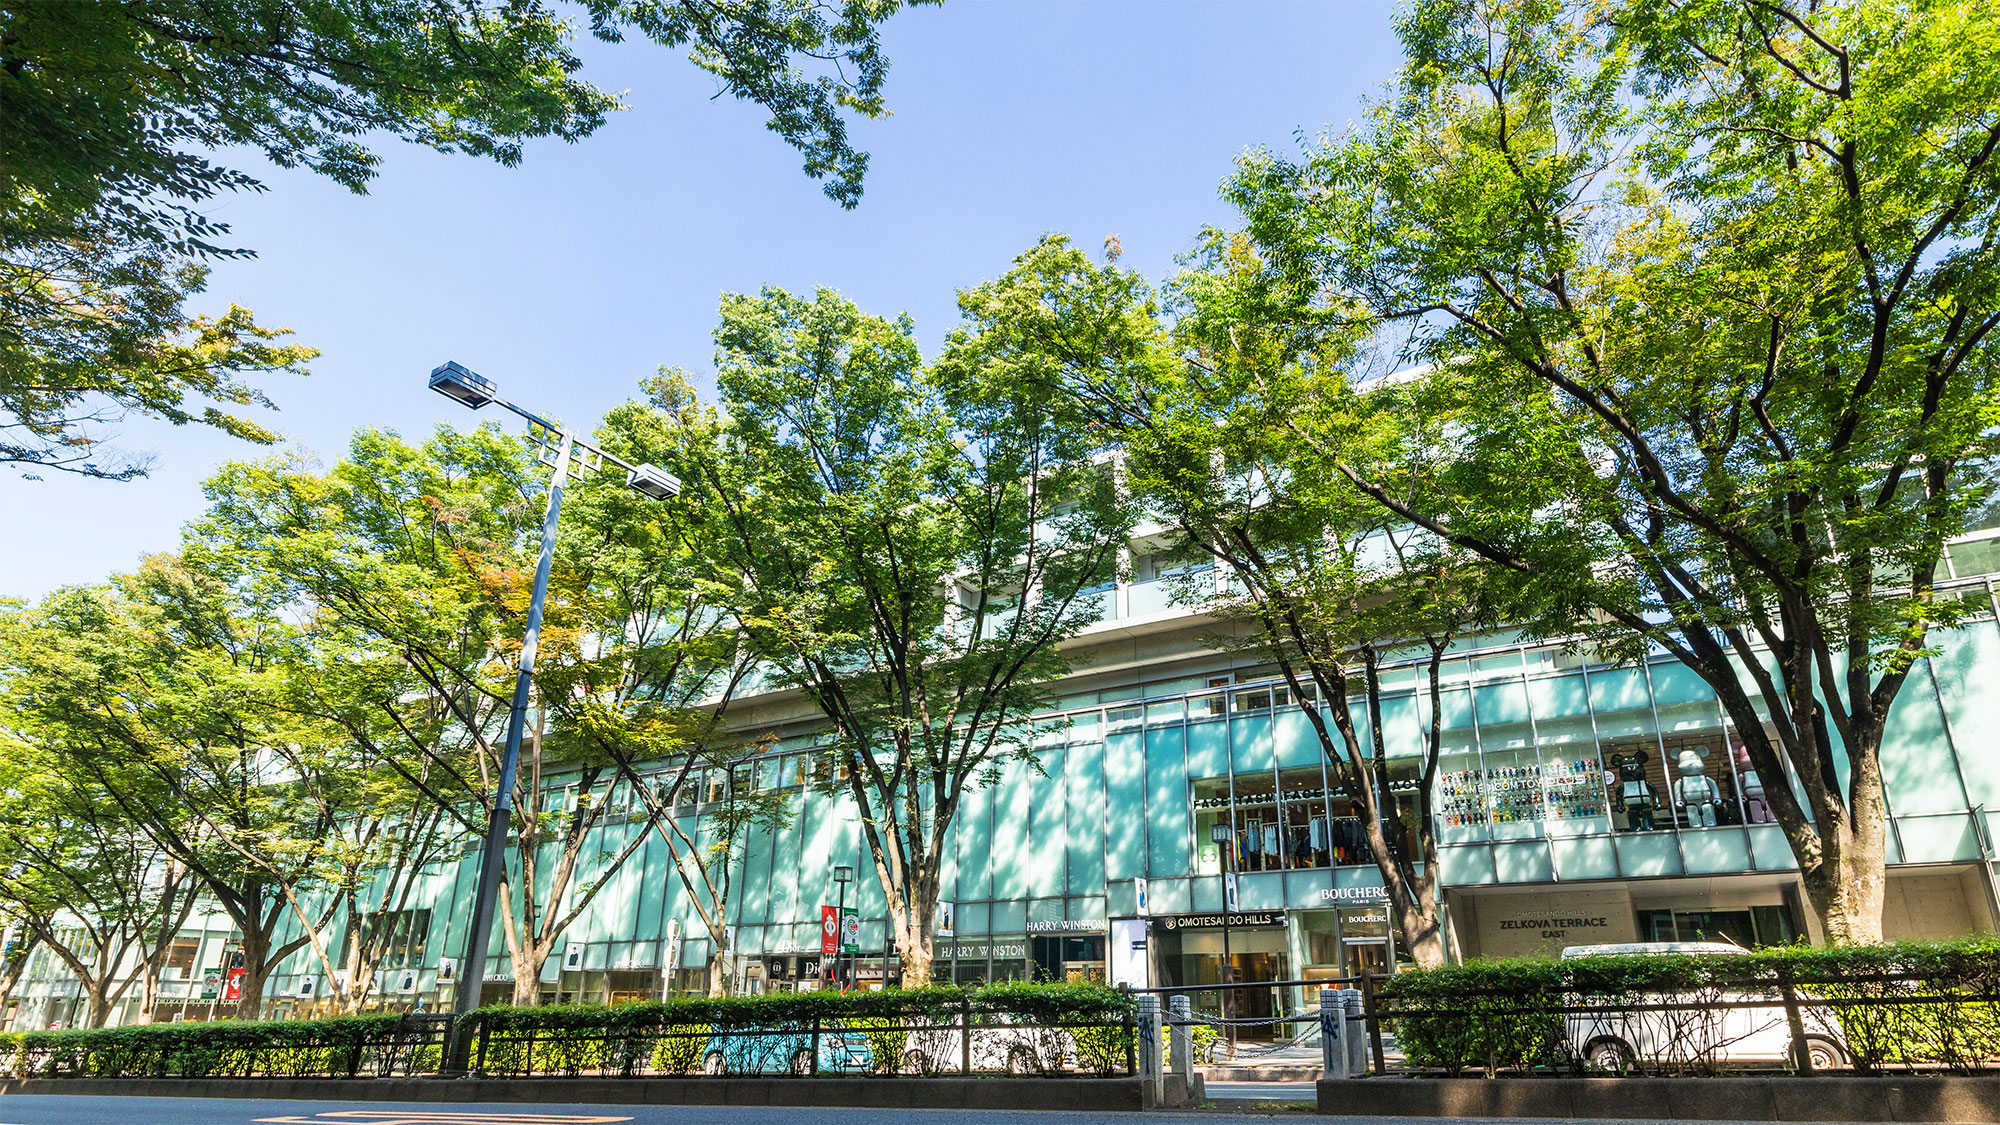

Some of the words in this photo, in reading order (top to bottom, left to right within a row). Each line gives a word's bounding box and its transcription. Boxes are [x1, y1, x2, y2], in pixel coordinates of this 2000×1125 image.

[1516, 910, 1566, 918] OMOTESANDO
[1567, 909, 1587, 917] HILLS
[1245, 914, 1271, 925] HILLS
[1500, 920, 1551, 930] ZELKOVA
[1552, 918, 1608, 928] TERRACE
[1027, 921, 1058, 932] HARRY
[1061, 919, 1105, 931] WINSTON
[1542, 930, 1566, 938] EAST
[978, 945, 1025, 957] WNSTON
